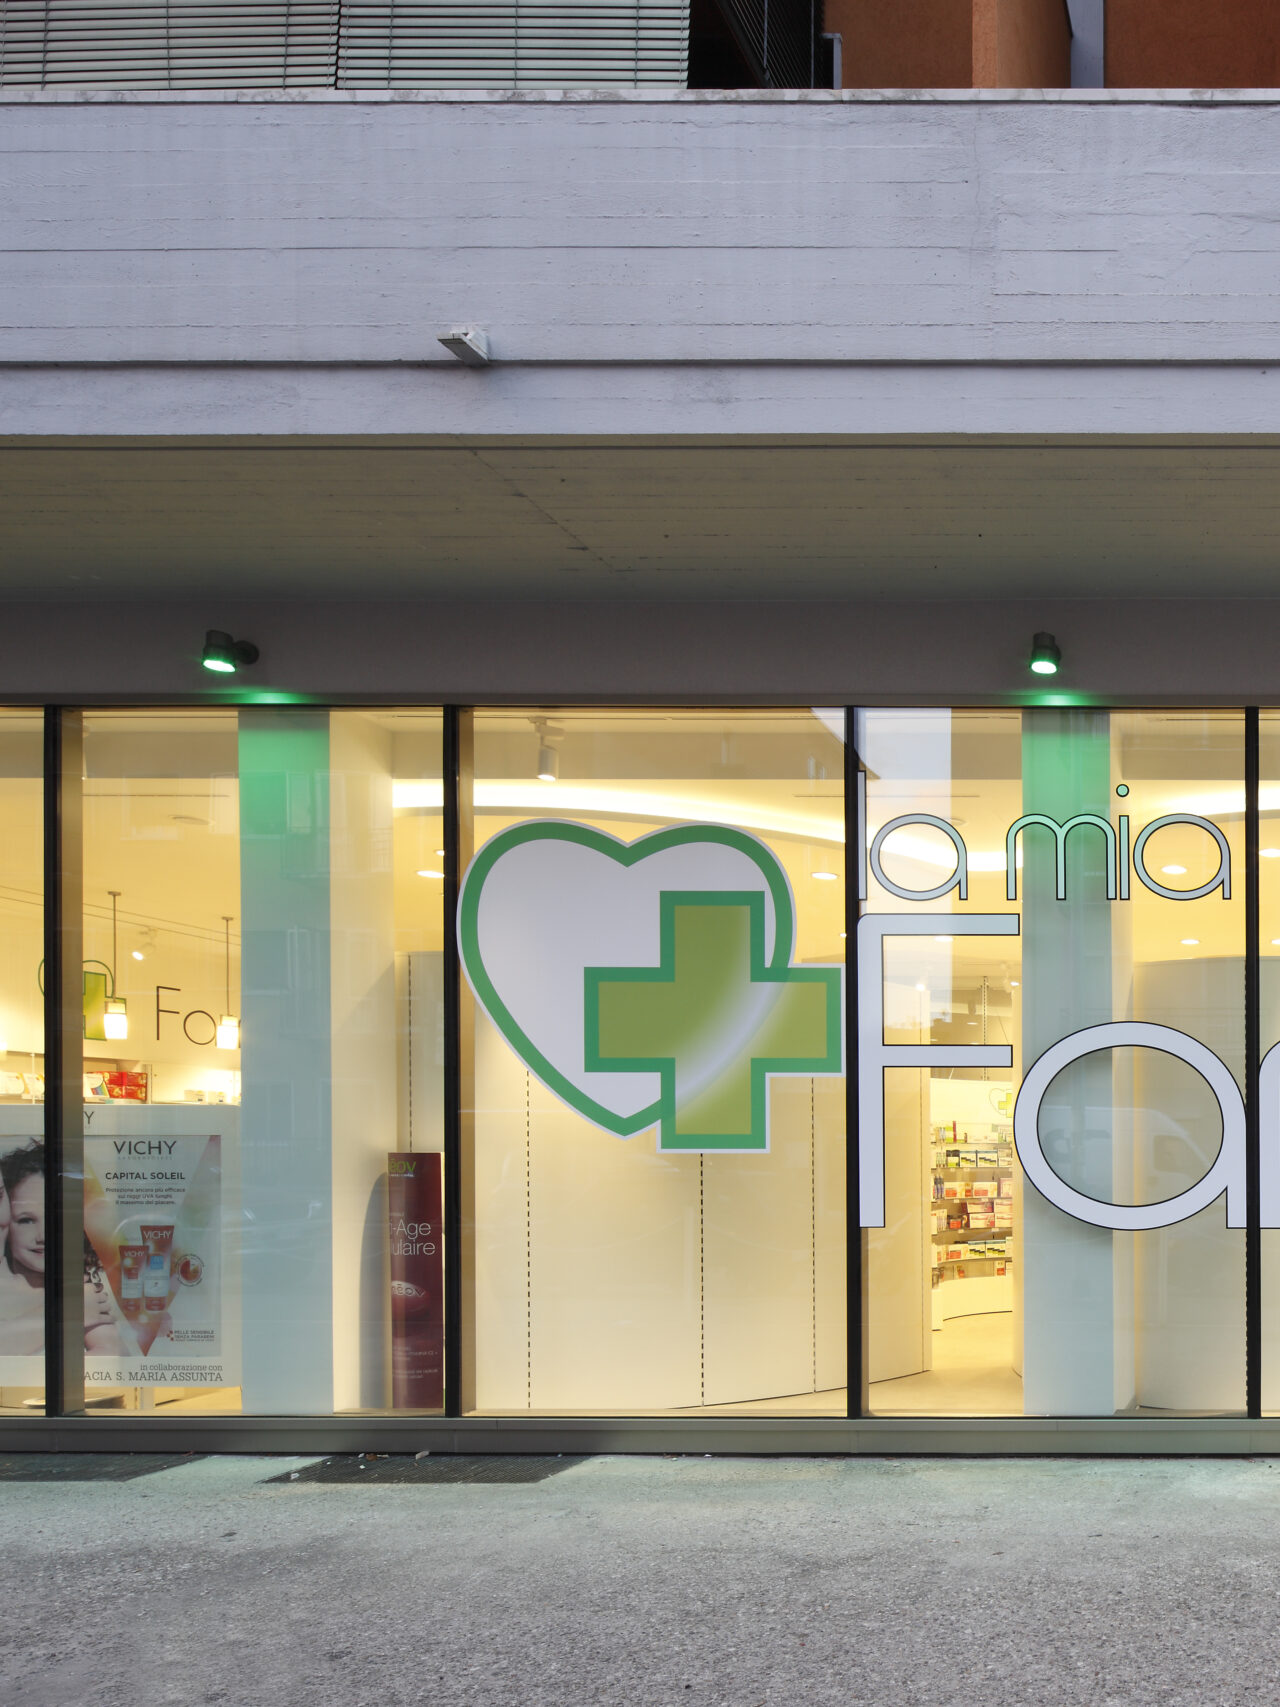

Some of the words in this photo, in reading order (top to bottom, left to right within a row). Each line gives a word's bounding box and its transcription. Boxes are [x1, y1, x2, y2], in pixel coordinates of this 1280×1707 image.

[857, 770, 968, 901] la
[1006, 784, 1232, 901] mia
[113, 1140, 177, 1155] VICHY
[105, 1172, 147, 1180] CAPITAL
[150, 1172, 186, 1180] SOLEIL
[143, 1230, 171, 1240] VICHY
[391, 1240, 435, 1256] ulaire
[140, 1363, 149, 1371] in
[149, 1363, 207, 1371] collaborazione
[84, 1372, 112, 1381] ACIA
[116, 1372, 126, 1381] S.
[128, 1372, 167, 1382] MARIA
[170, 1372, 224, 1382] ASSUNTA
